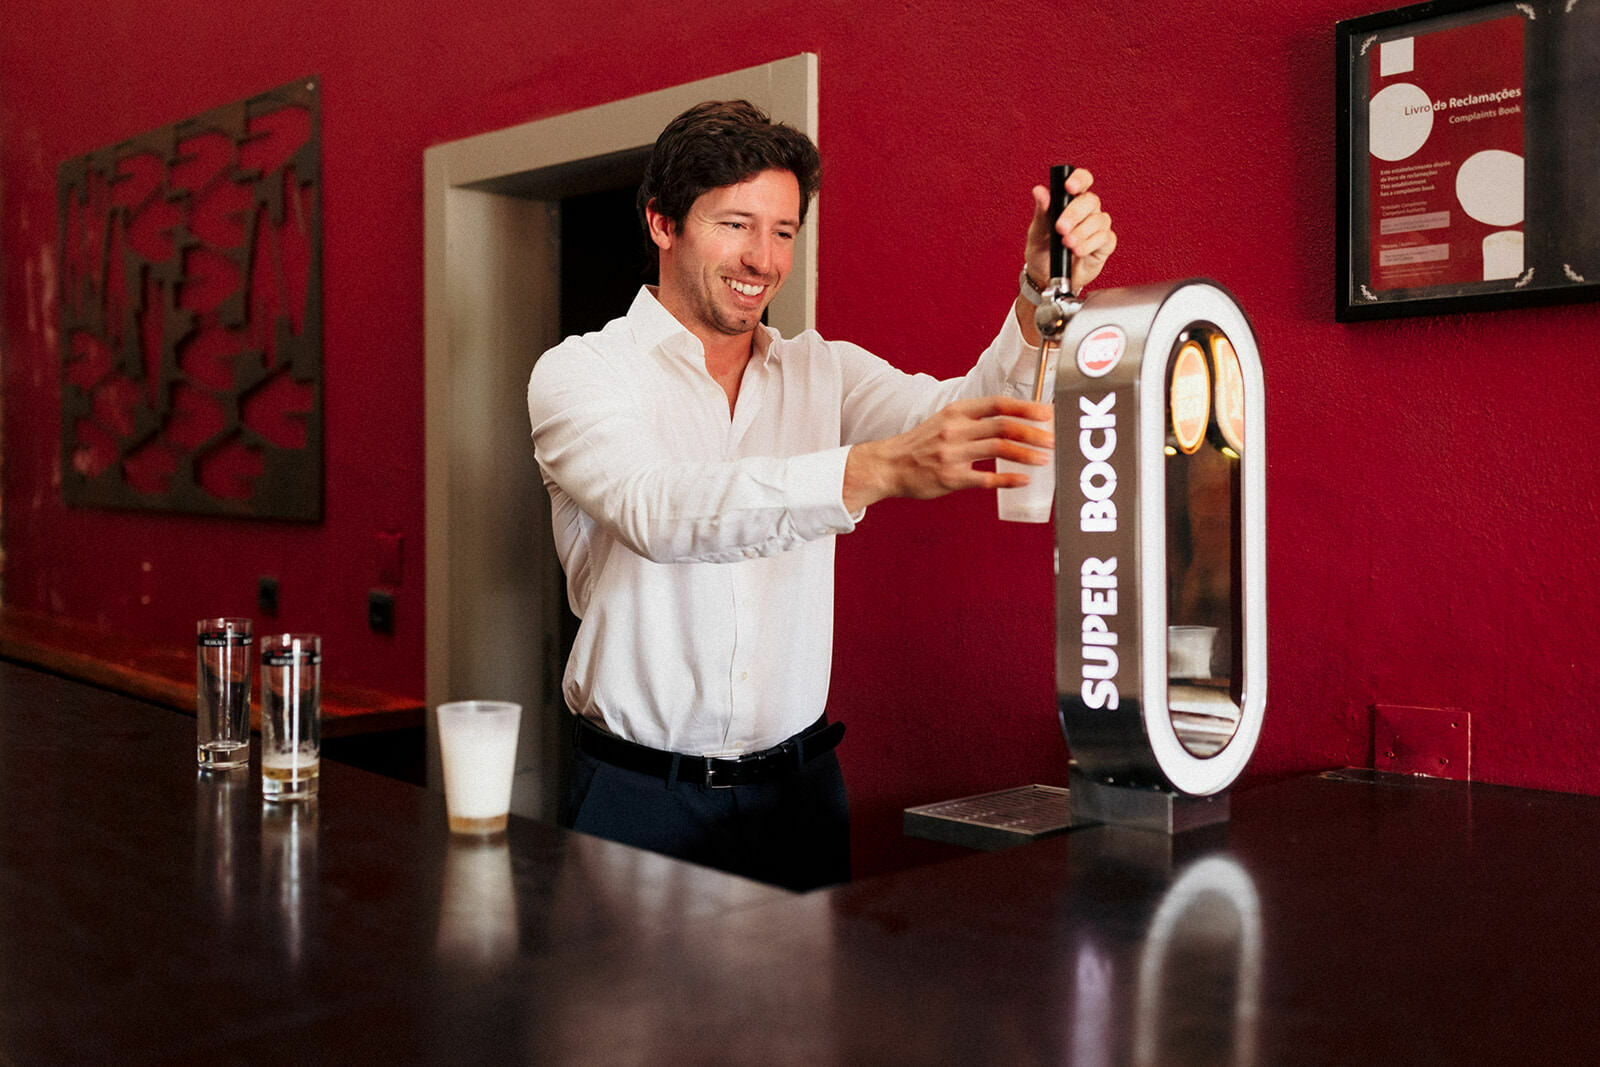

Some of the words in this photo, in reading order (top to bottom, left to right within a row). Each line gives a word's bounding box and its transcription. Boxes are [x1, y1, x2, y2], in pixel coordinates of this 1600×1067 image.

[1404, 104, 1430, 116] Livro
[1449, 88, 1521, 109] Reclamações
[1449, 109, 1496, 124] Complaints
[1498, 105, 1521, 116] Book
[1079, 391, 1117, 532] BOCK
[1081, 556, 1119, 710] SUPER
